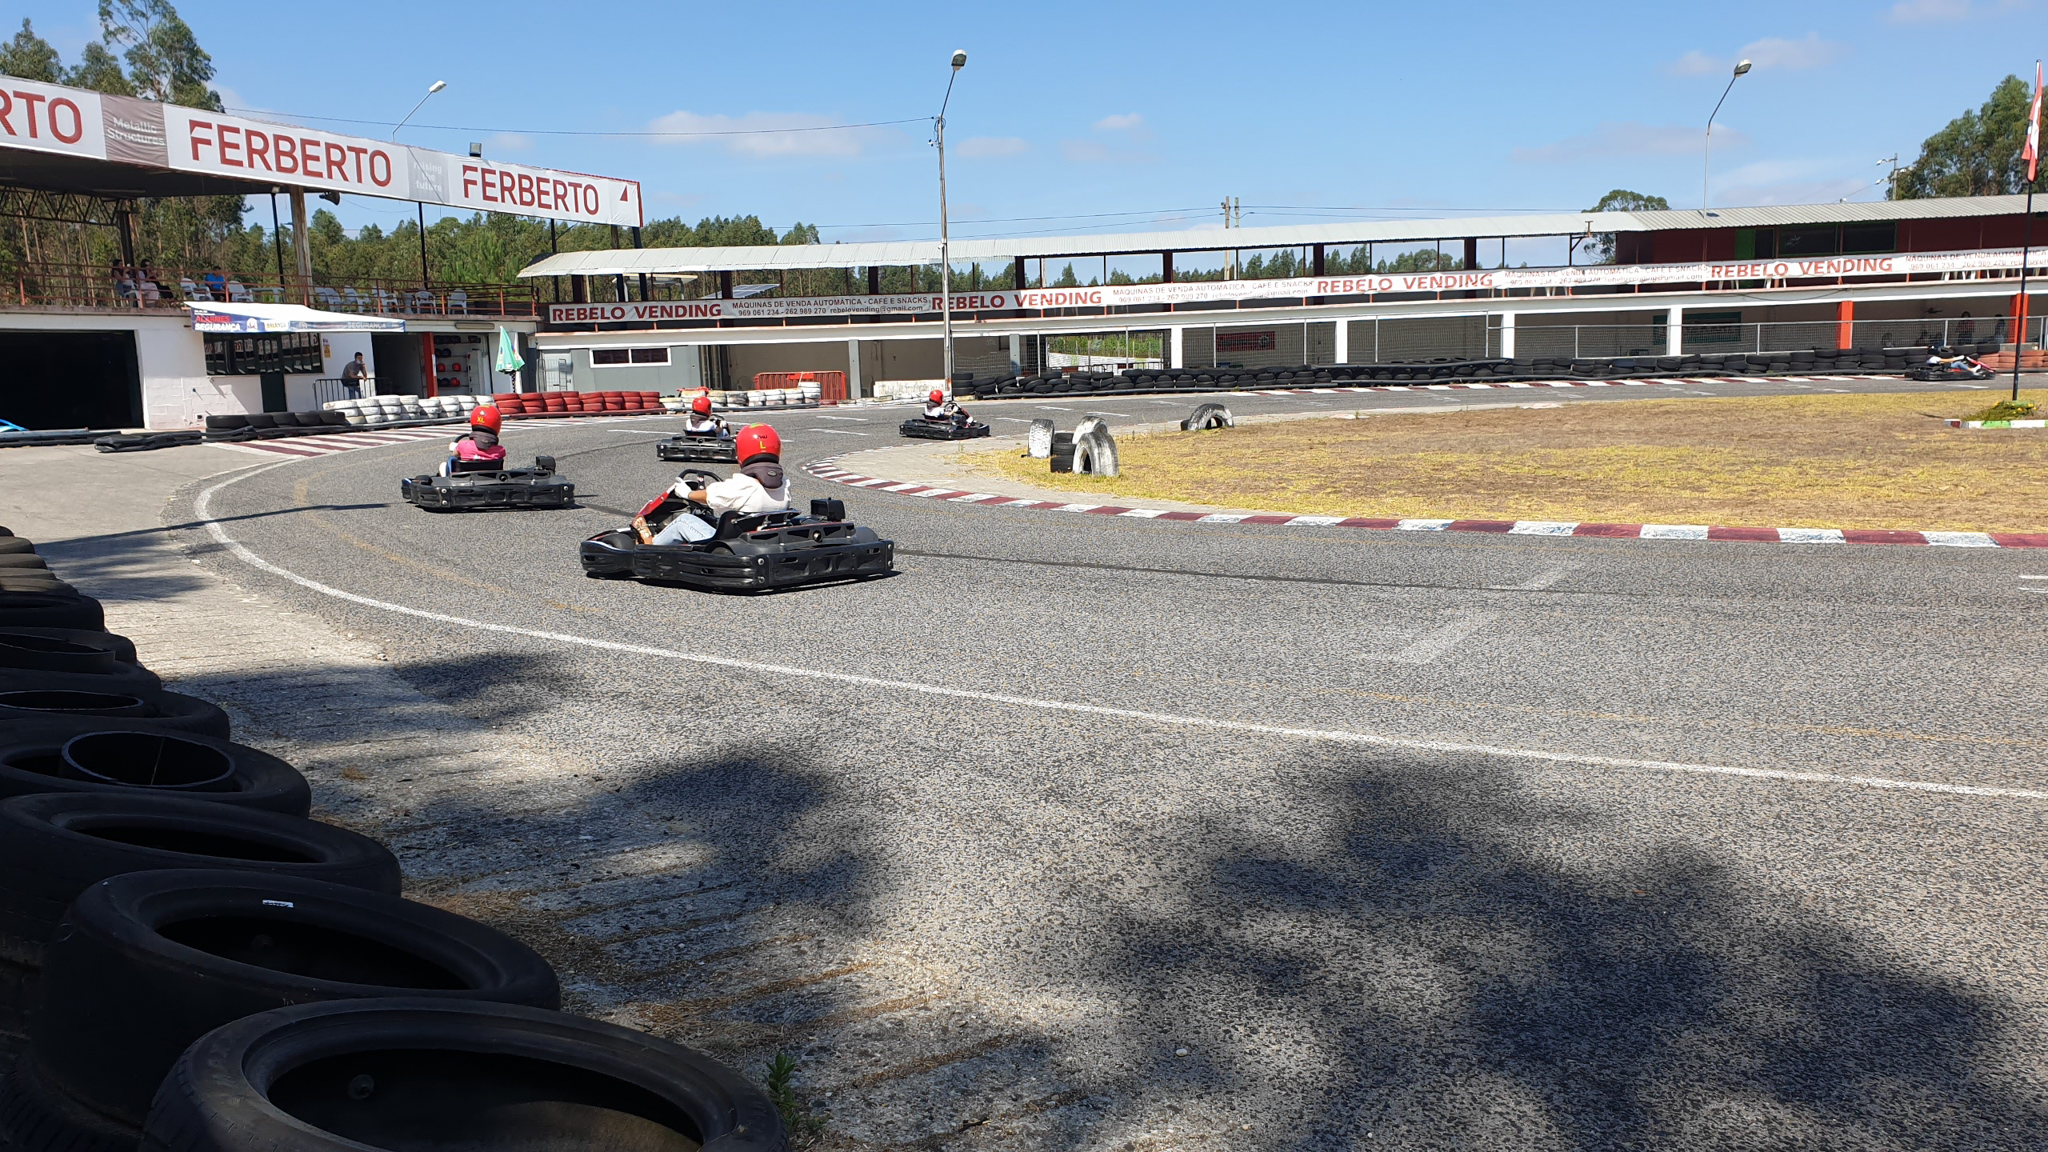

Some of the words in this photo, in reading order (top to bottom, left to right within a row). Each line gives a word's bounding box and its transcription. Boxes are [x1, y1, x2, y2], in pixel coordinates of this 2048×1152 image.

[113, 117, 157, 133] Metallic
[107, 128, 165, 146] Structures
[189, 119, 392, 187] FERBERTO
[462, 164, 600, 215] FERBERTO
[1711, 263, 1789, 278] REBELO
[1799, 258, 1893, 275] VENDING
[1317, 278, 1393, 293] REBELO
[1403, 273, 1493, 289] VENDING
[732, 301, 772, 309] MÁQUINAS
[785, 299, 811, 307] VENDA
[813, 298, 862, 307] AUTOMÁTICA
[897, 296, 928, 304] SNACKS
[932, 294, 1006, 310] REBELO
[1013, 291, 1102, 307] VENDING
[552, 306, 626, 322] REBELO
[634, 303, 722, 319] VENDING
[760, 440, 766, 449] L
